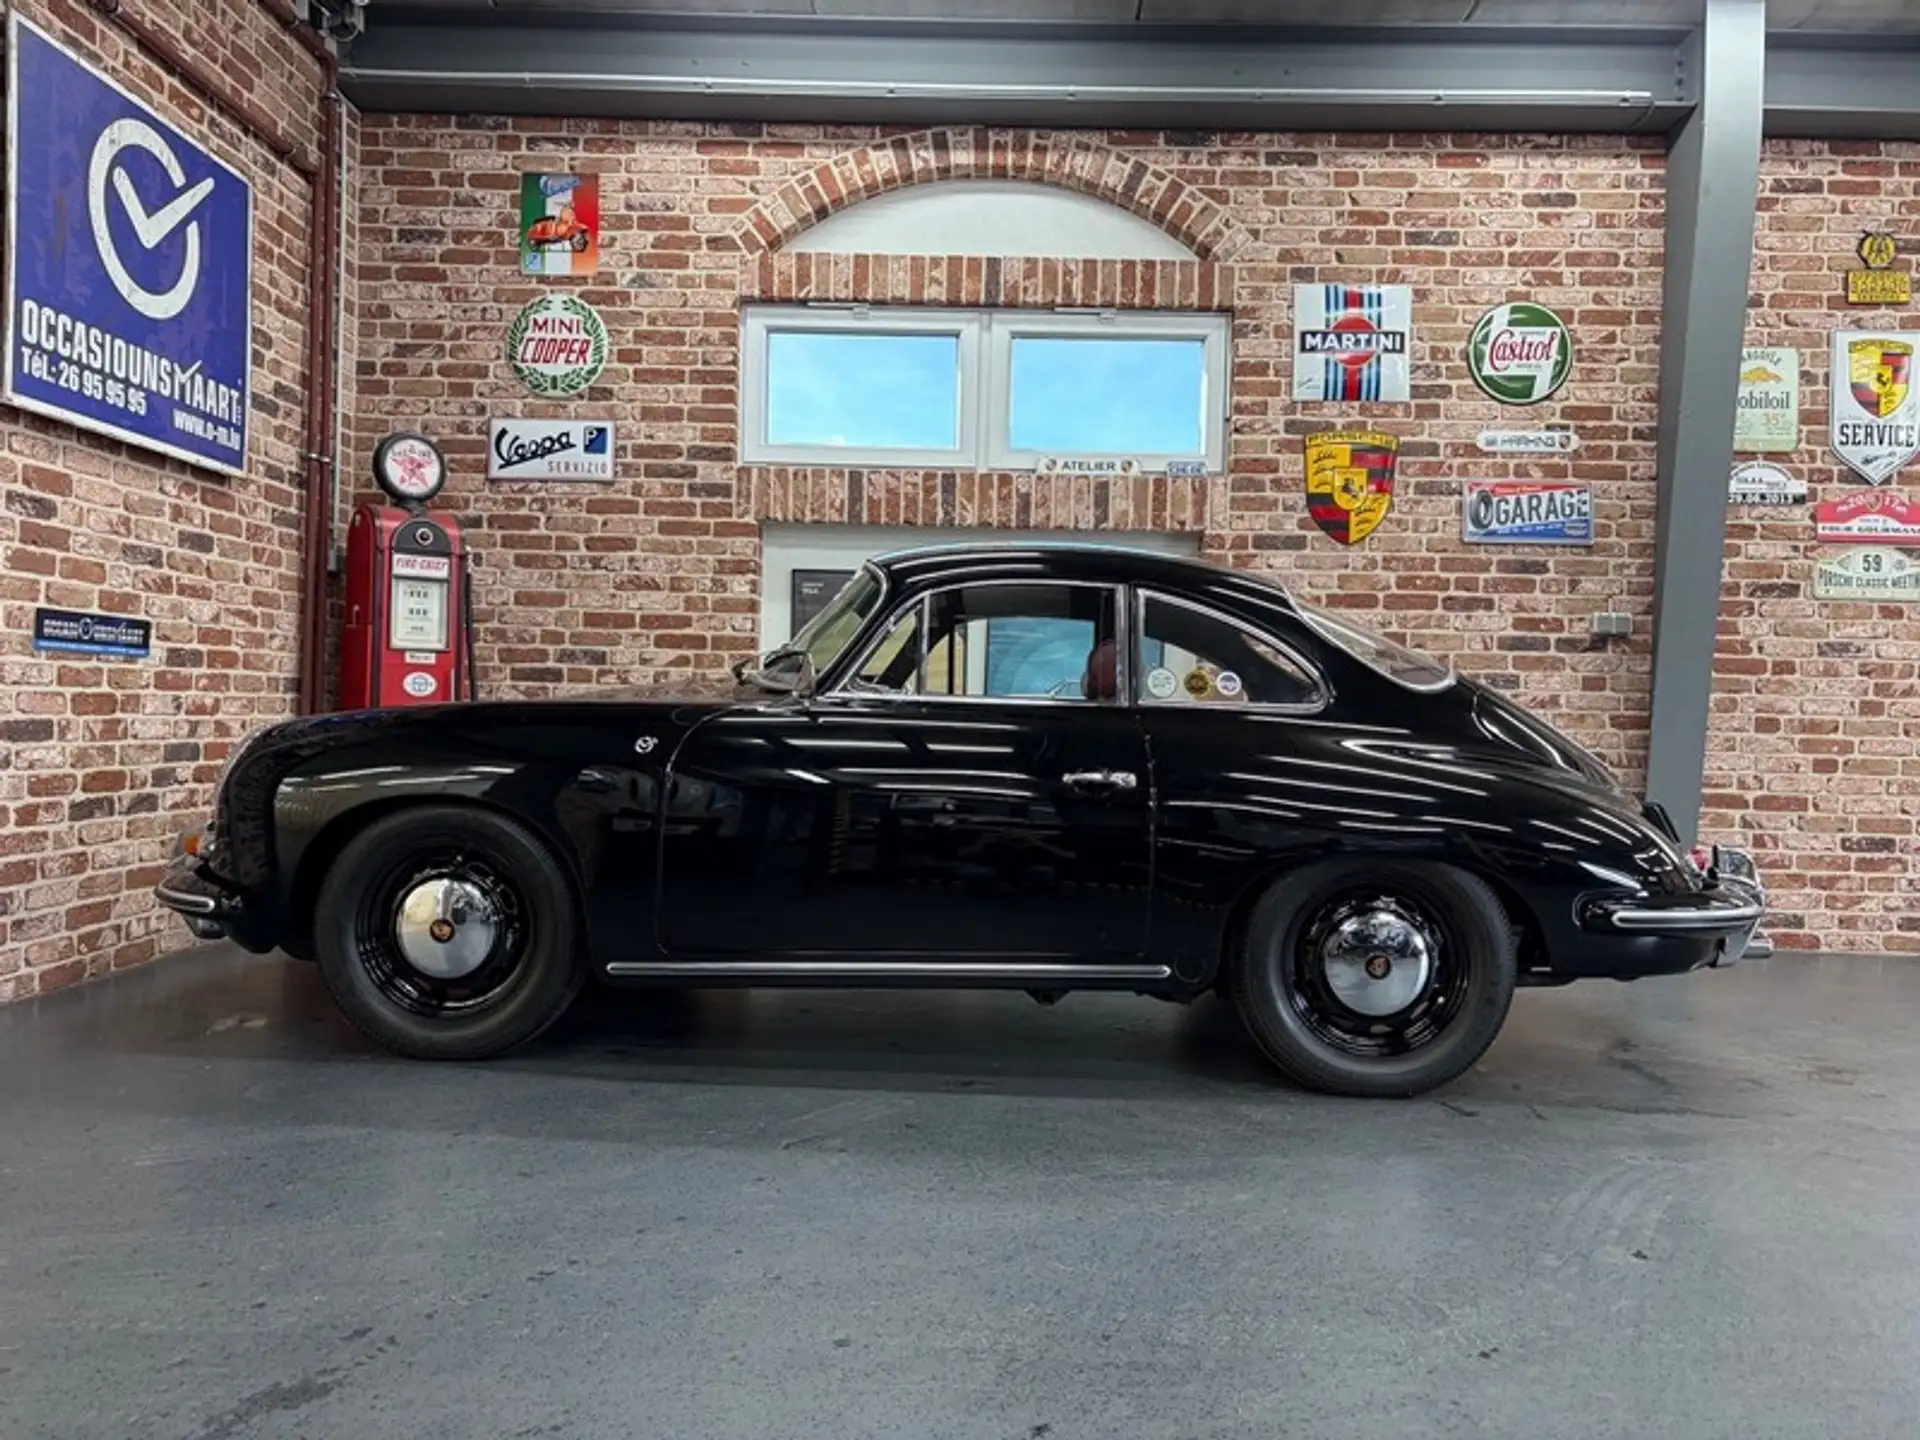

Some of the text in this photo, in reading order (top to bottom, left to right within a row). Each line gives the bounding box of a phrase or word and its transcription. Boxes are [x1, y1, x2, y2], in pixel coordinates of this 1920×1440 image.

[532, 318, 580, 334] MINI
[520, 338, 591, 364] COOPER
[1305, 333, 1401, 350] MARTINI
[1489, 329, 1557, 372] Castrol
[58, 361, 80, 392] 26
[82, 369, 103, 401] 95
[105, 379, 125, 408] 95
[127, 386, 147, 416] 95
[1736, 391, 1790, 409] obiloil
[1839, 423, 1914, 447] SERVICE
[495, 427, 577, 470] Vespa
[548, 461, 608, 474] SERVIZIO
[1061, 460, 1116, 472] ATELIER
[1495, 490, 1588, 525] GARAGE
[1862, 554, 1882, 573] 59
